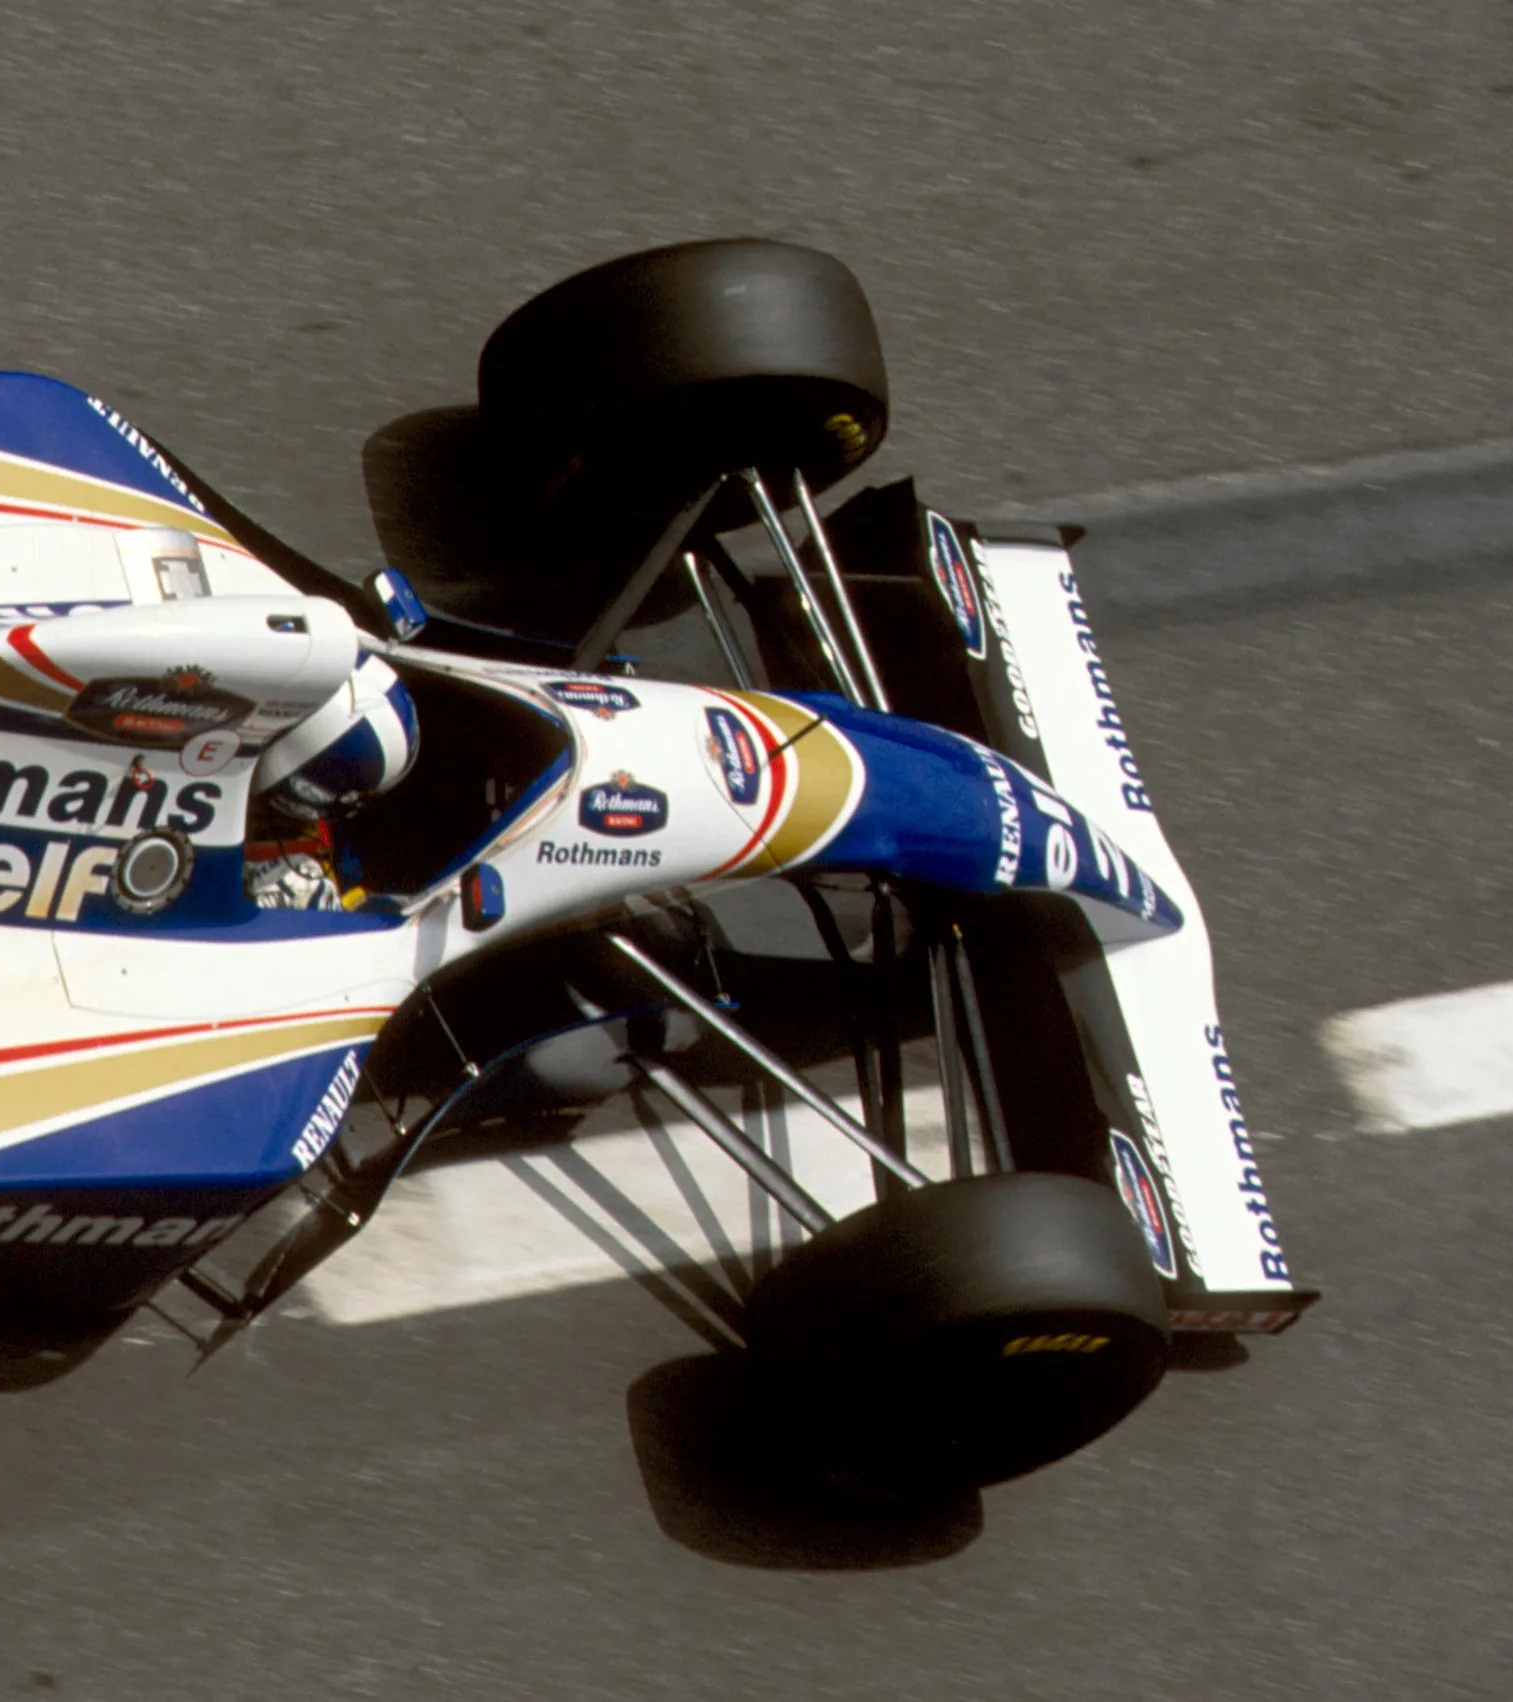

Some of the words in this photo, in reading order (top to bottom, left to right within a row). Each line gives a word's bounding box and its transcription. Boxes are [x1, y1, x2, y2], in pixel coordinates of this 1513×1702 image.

[197, 740, 223, 762] E
[1059, 571, 1153, 813] Rothmans
[536, 840, 662, 867] Rothmans
[291, 1049, 361, 1172] RENAULT
[1204, 1023, 1291, 1284] Rothmans
